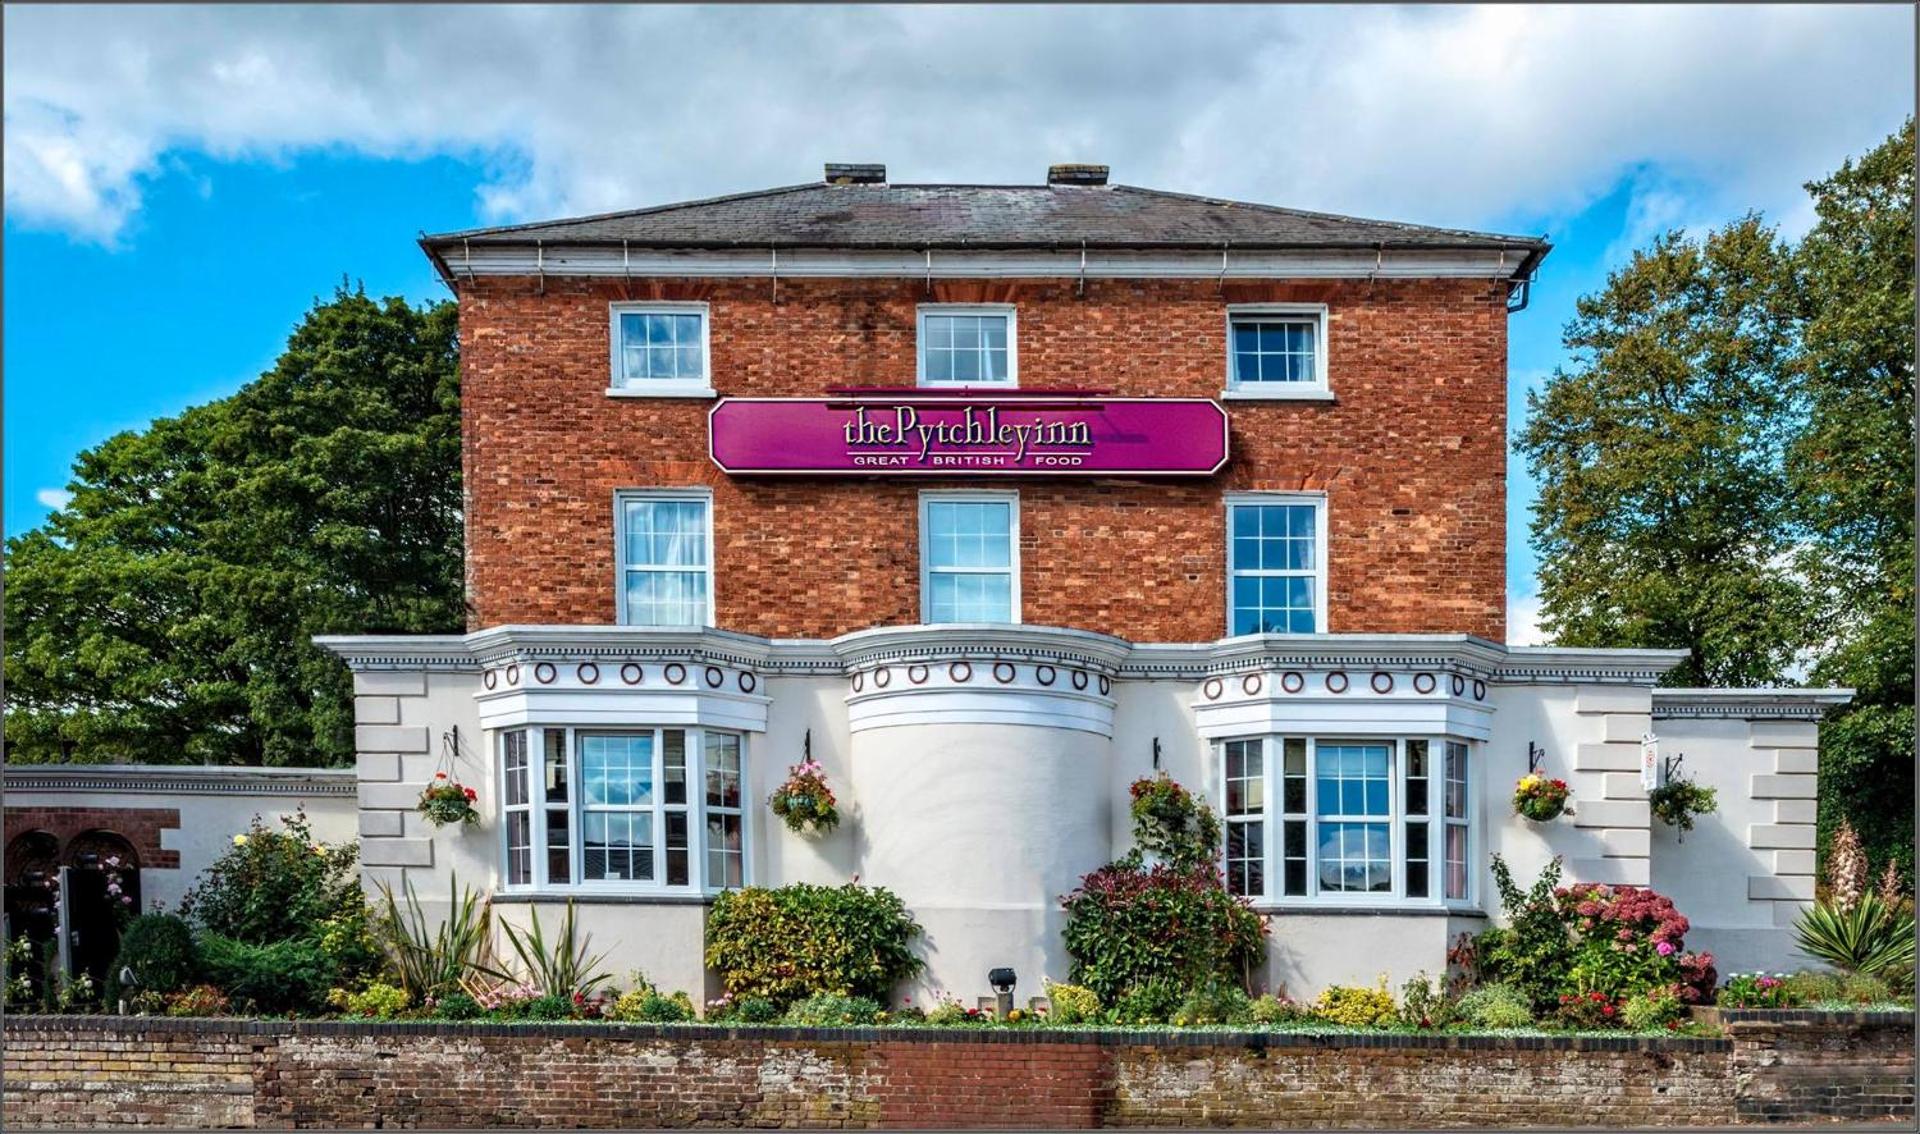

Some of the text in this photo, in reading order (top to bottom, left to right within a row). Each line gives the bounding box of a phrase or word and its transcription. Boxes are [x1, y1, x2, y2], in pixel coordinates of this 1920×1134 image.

[853, 456, 1083, 466] GREAT BRITISH FOOD
